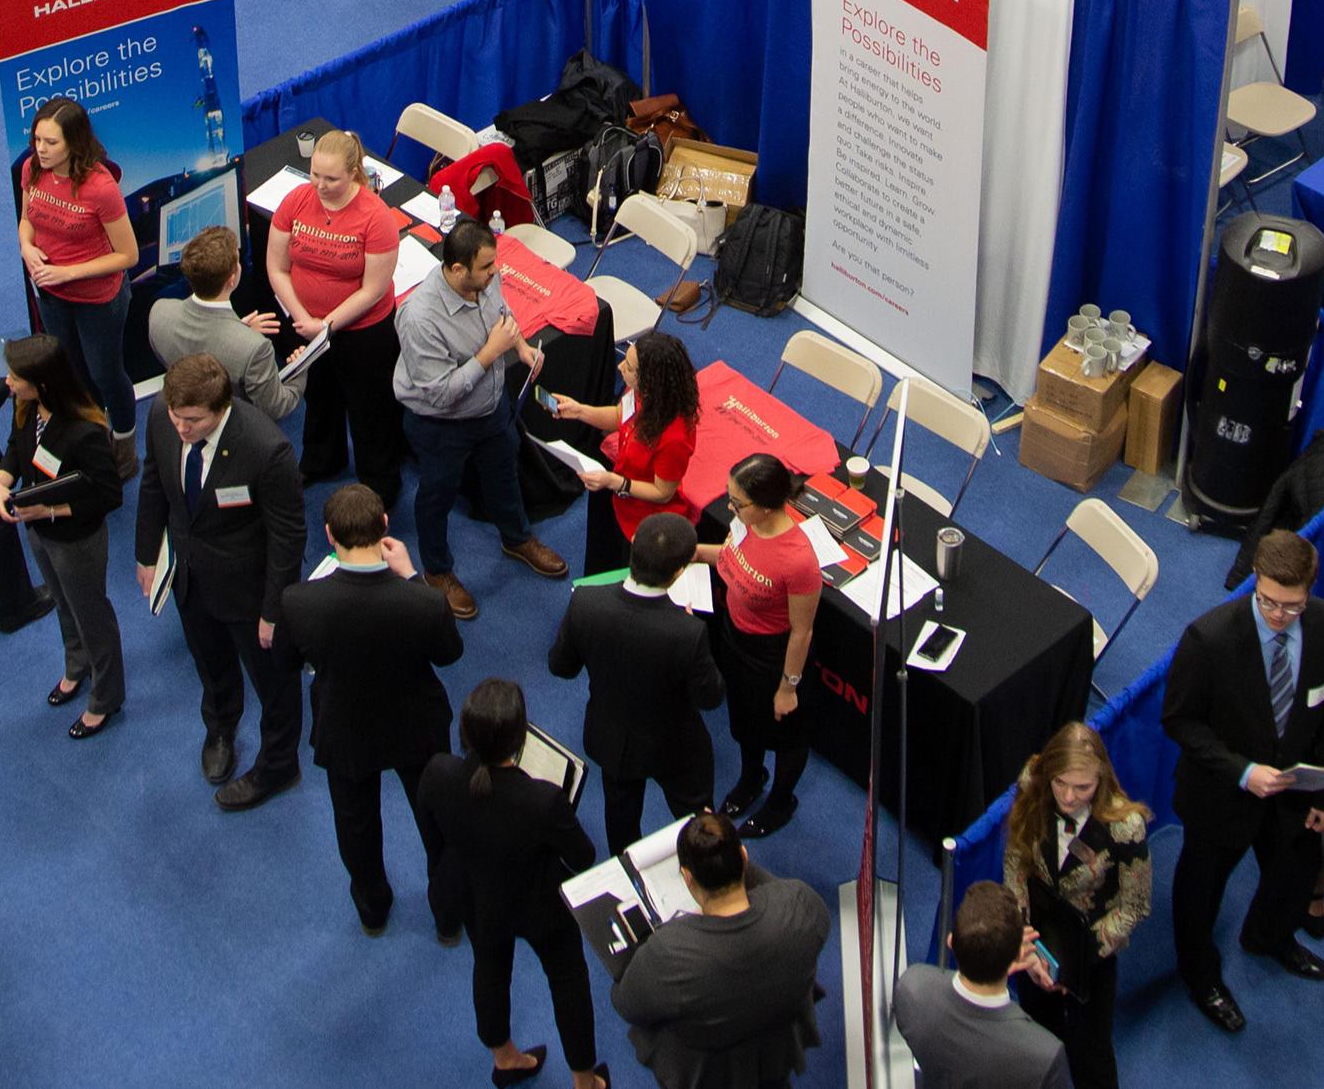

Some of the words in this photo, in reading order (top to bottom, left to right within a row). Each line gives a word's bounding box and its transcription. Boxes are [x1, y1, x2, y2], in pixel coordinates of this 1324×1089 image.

[16, 49, 110, 92] Explore
[117, 36, 158, 61] the
[841, 16, 943, 94] Possibilities
[912, 37, 942, 68] the
[838, 61, 860, 83] bring
[861, 75, 890, 100] energy
[856, 58, 882, 79] career
[901, 82, 924, 105] helps
[837, 91, 866, 115] people
[853, 130, 892, 159] challenge
[908, 166, 934, 186] status
[888, 135, 924, 165] Innovate
[28, 185, 86, 214] Halliburton
[834, 174, 858, 197] better
[859, 191, 885, 214] future
[835, 160, 880, 197] Collaborate
[892, 198, 918, 221] create
[291, 218, 358, 244] Halliburton
[833, 204, 875, 235] workplace
[895, 242, 929, 271] limitless
[834, 190, 861, 213] ethical
[878, 218, 913, 246] dynamic
[498, 262, 552, 297] Halliburton
[831, 260, 910, 317] halliburton.com/careers
[881, 272, 915, 297] person?
[722, 394, 780, 440] Halliburton
